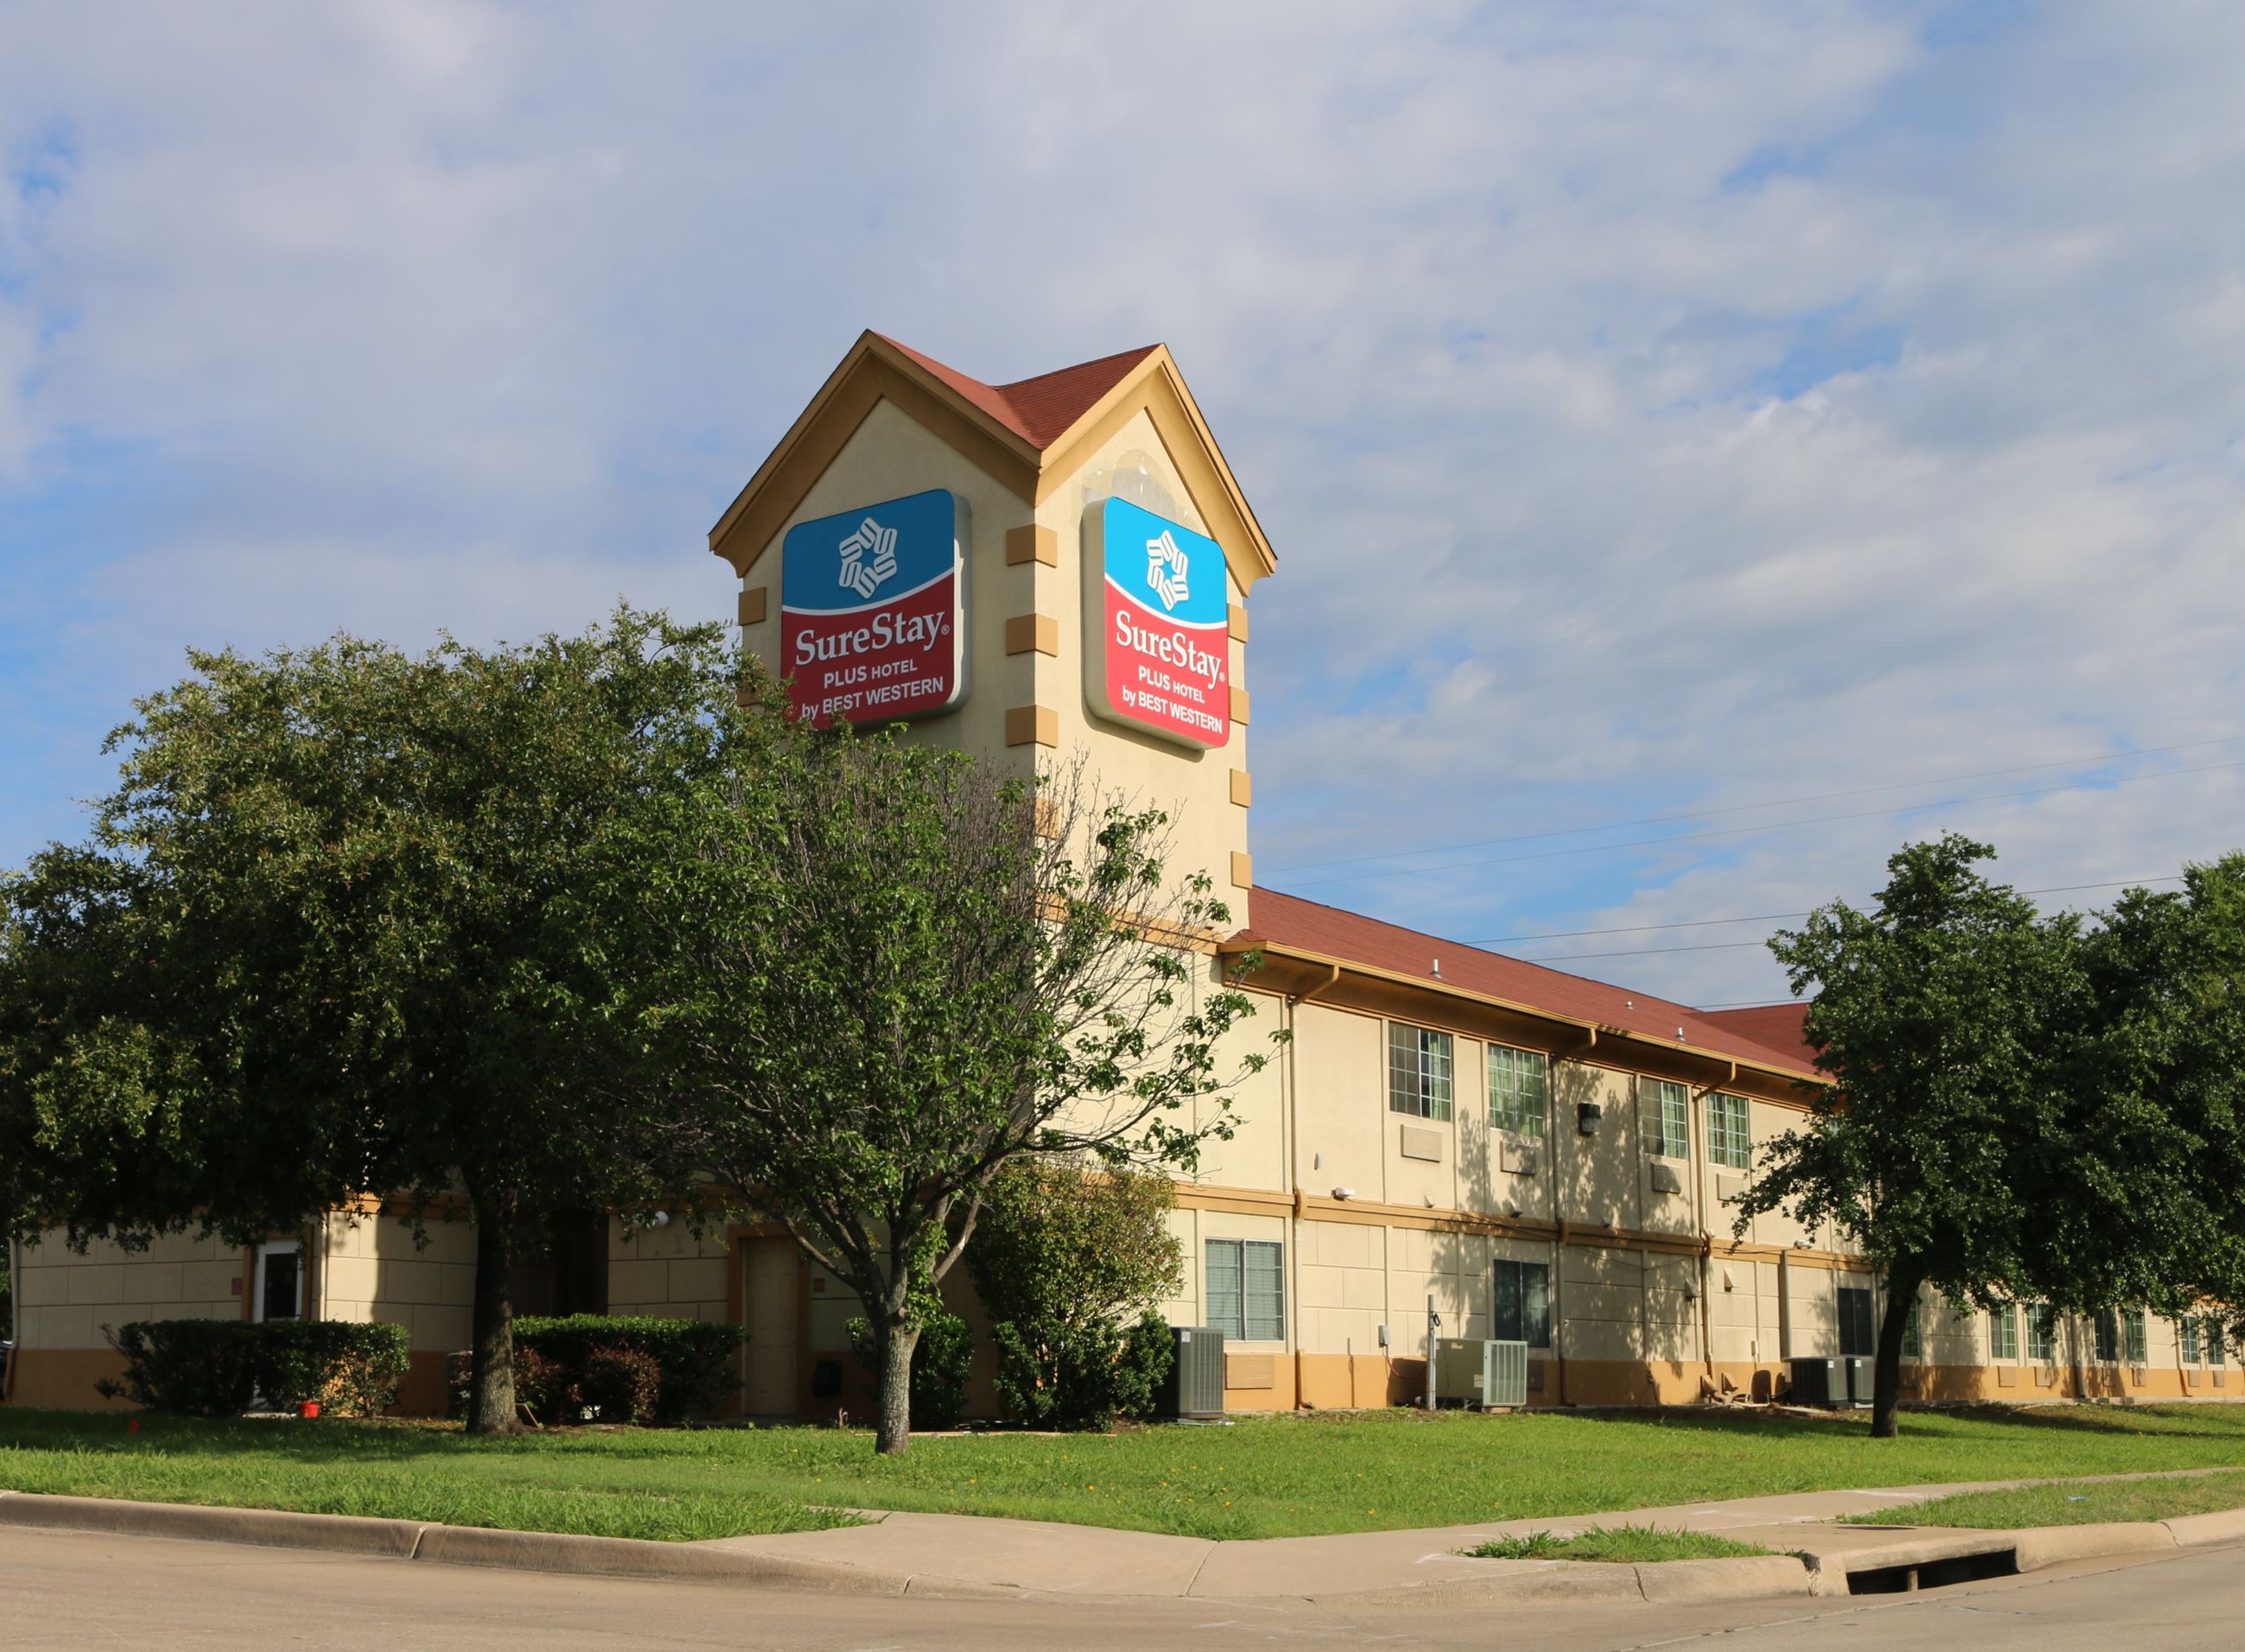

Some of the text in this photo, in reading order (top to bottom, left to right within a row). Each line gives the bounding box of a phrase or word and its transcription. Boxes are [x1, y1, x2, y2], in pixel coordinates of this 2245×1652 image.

[824, 659, 918, 689] PLUS HOTEL
[1138, 665, 1205, 704] PLUS HOTEL
[801, 676, 944, 720] by BEST WESTERN
[1122, 686, 1223, 734] by BEST WESTERN
